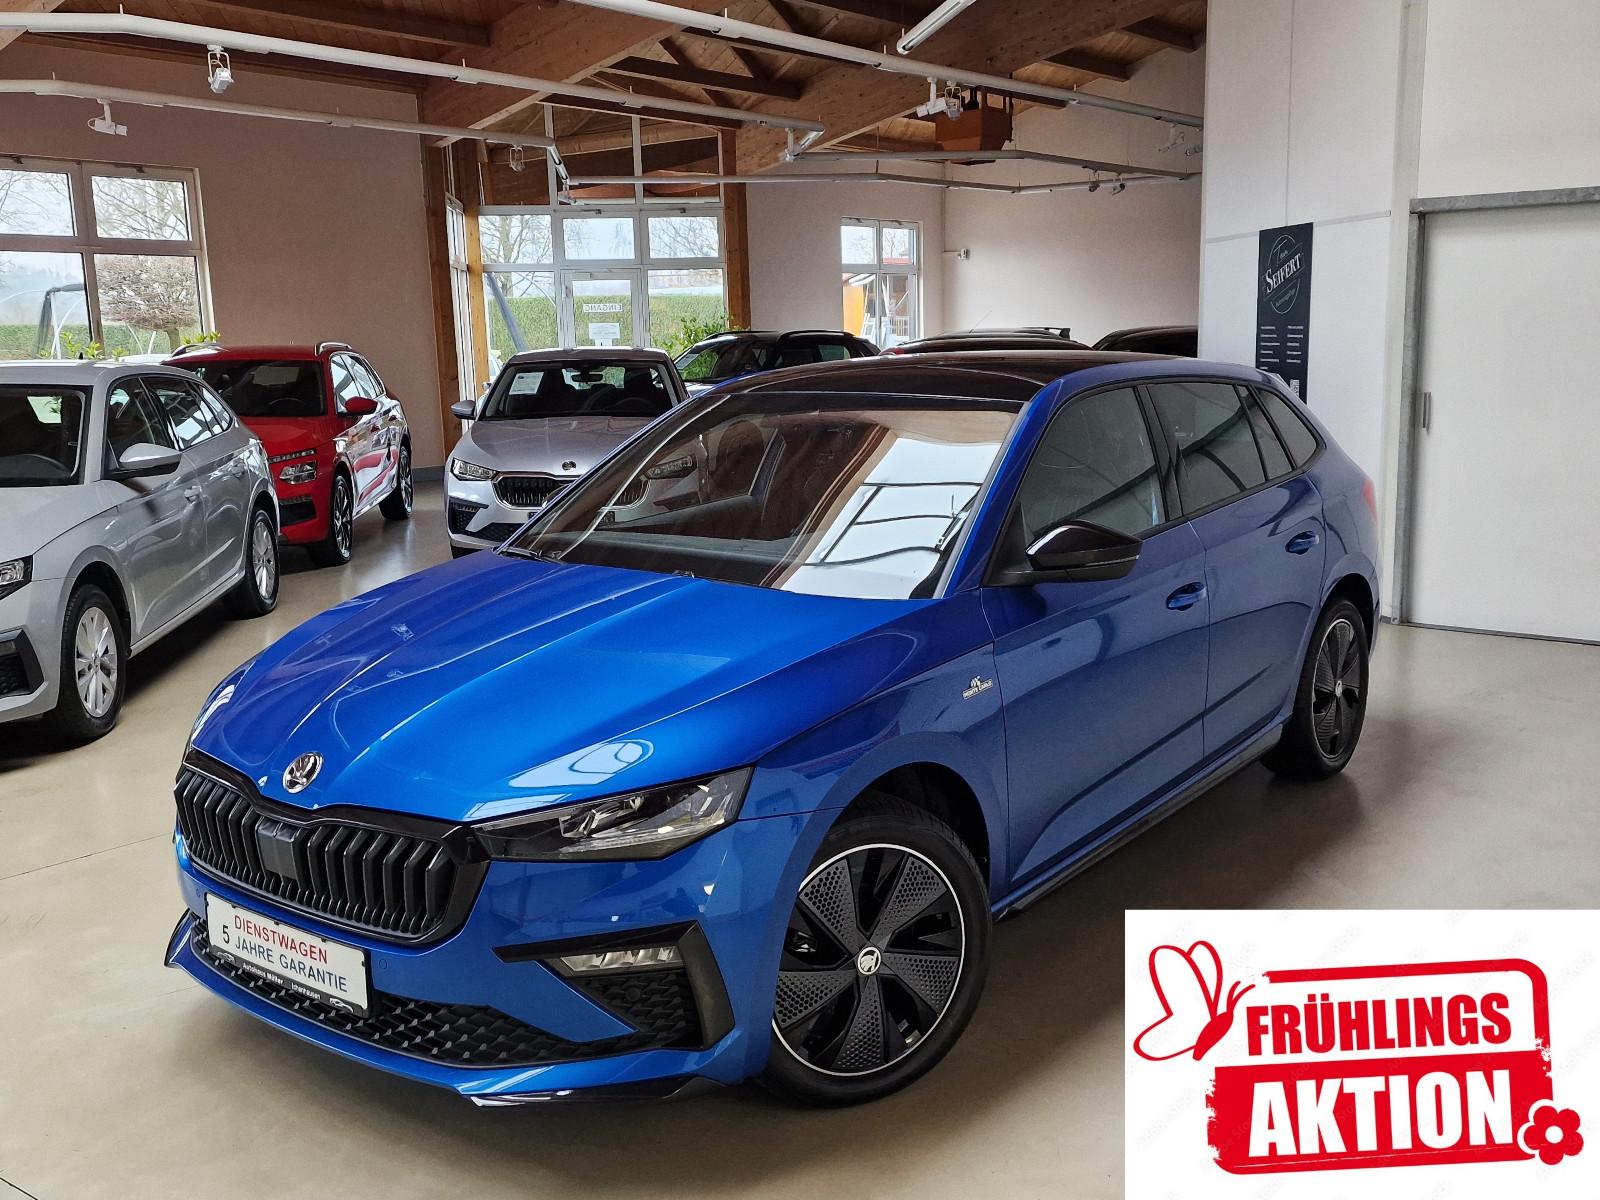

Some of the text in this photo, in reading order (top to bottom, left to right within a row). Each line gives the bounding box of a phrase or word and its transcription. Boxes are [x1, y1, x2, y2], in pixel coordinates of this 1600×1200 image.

[1265, 253, 1301, 293] SEIFERT
[222, 924, 230, 944] 5
[235, 936, 275, 964] JAHRE
[279, 954, 348, 993] GARANTIE
[234, 915, 328, 964] DIENSTWAGEN
